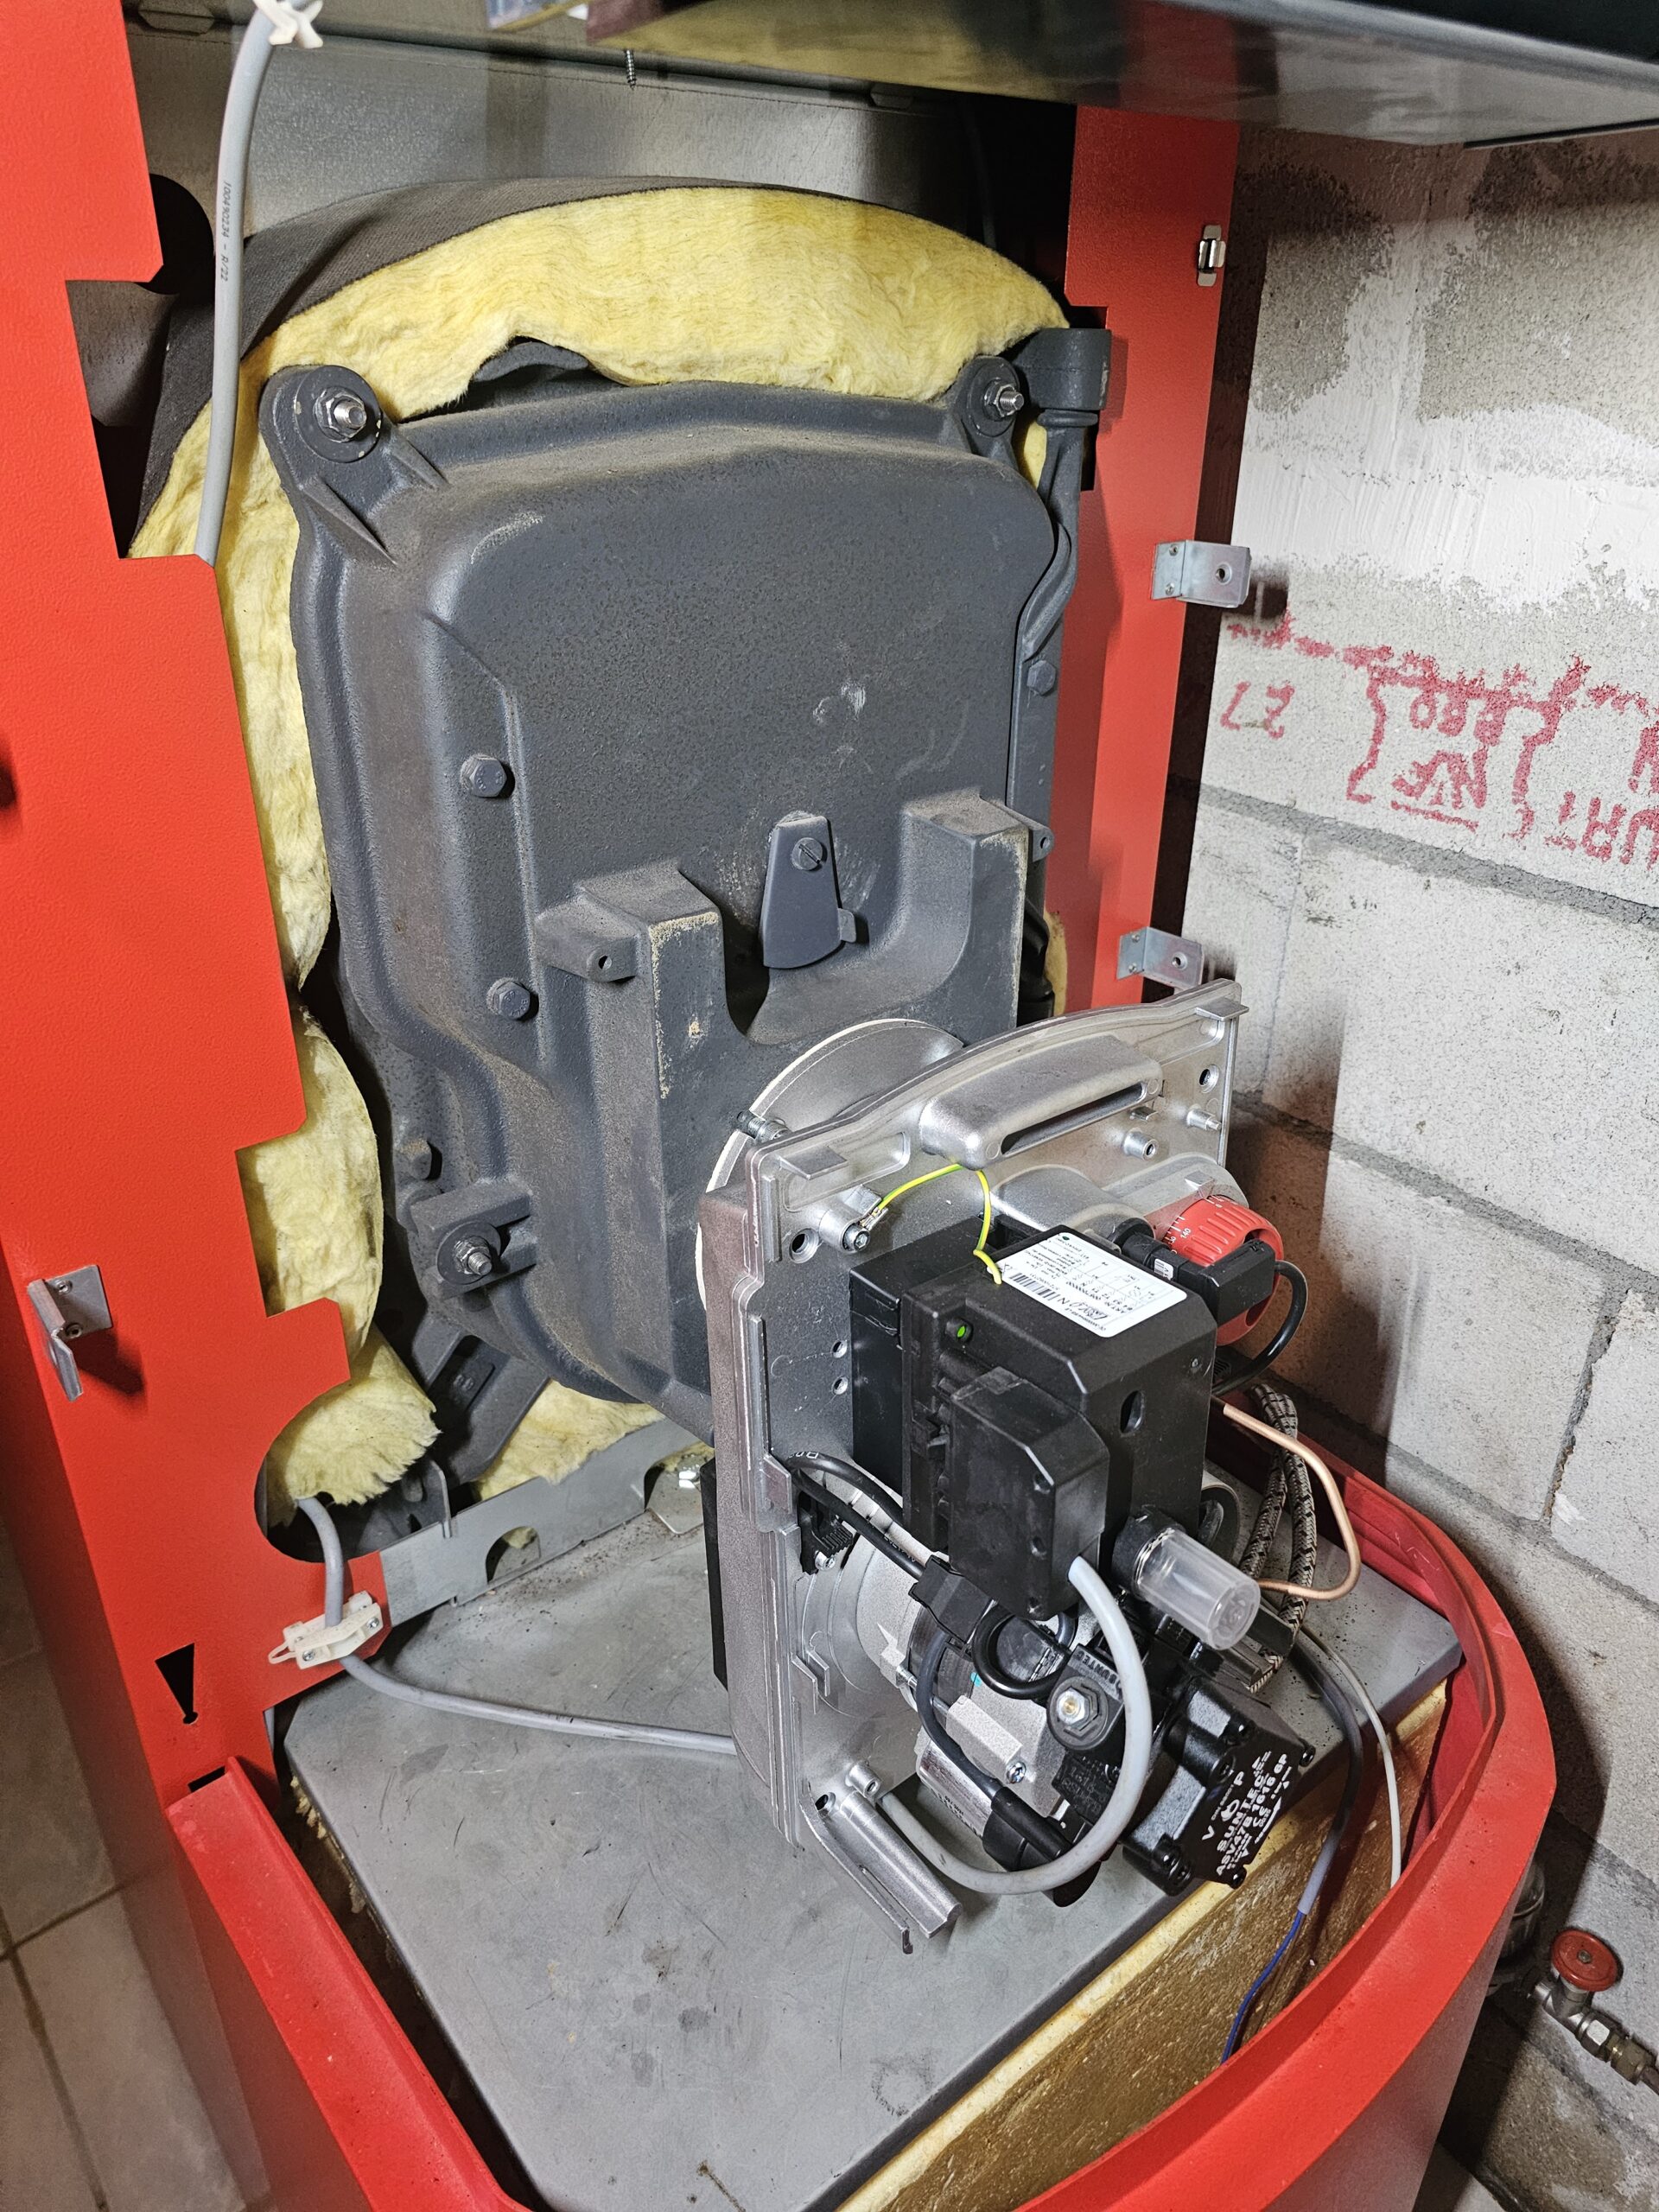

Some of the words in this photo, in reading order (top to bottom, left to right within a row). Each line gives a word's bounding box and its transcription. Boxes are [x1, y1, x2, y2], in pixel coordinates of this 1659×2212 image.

[221, 180, 232, 238] 100490234
[1220, 680, 1295, 741] 27
[1179, 1228, 1191, 1239] 140
[1072, 1650, 1117, 1684] SUNTEC
[1233, 1771, 1245, 1786] P
[1202, 1825, 1215, 1840] V
[1216, 1816, 1253, 1876] ASV47B
[1251, 1776, 1276, 1812] 1616
[1274, 1754, 1287, 1774] 6P
[1217, 1775, 1265, 1852] SUNTEC
